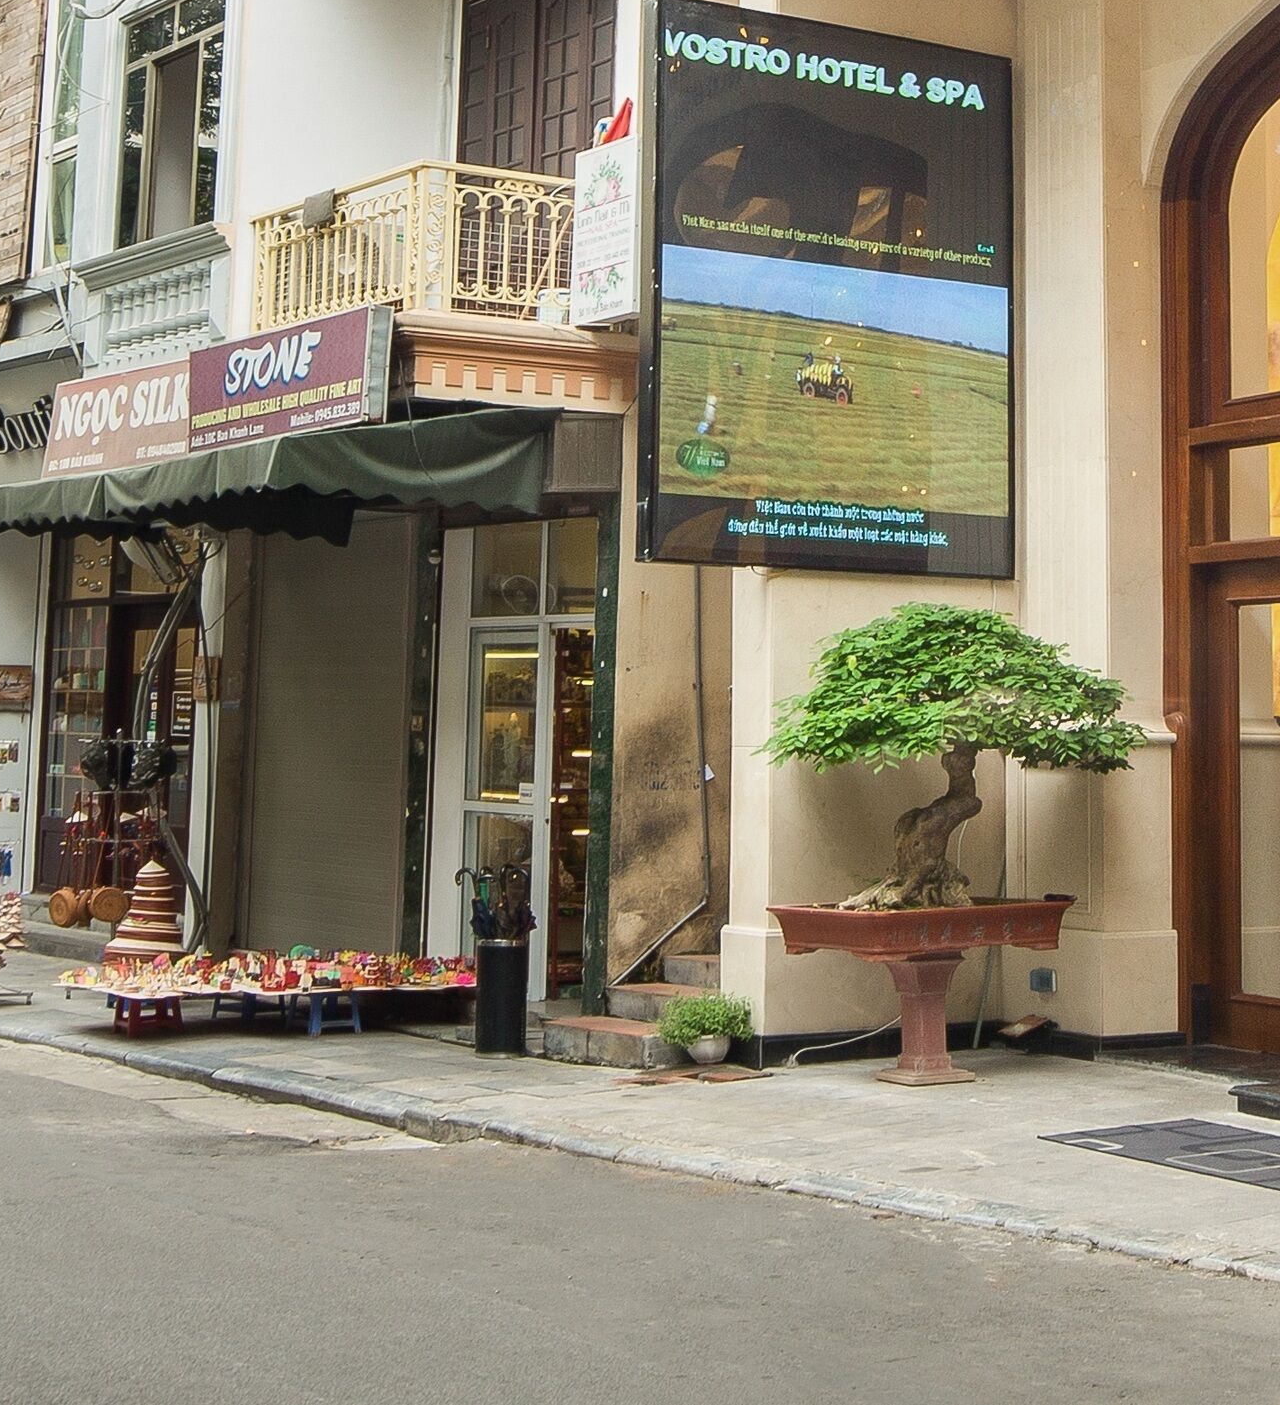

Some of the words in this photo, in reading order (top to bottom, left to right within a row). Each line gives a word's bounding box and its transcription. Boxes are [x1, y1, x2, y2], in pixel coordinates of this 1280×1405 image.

[665, 28, 791, 75] VOSTRO
[796, 52, 895, 95] HOTEL
[898, 72, 922, 99] &
[925, 76, 986, 110] SPA
[224, 329, 322, 395] STONE
[54, 384, 129, 446] NGỌC
[129, 372, 190, 428] SILK
[227, 404, 242, 421] AND
[242, 396, 281, 418] WHOLESALE
[299, 385, 329, 408] QUALITY
[328, 381, 347, 399] FINE
[346, 378, 363, 395] ART
[249, 424, 265, 436] Lane
